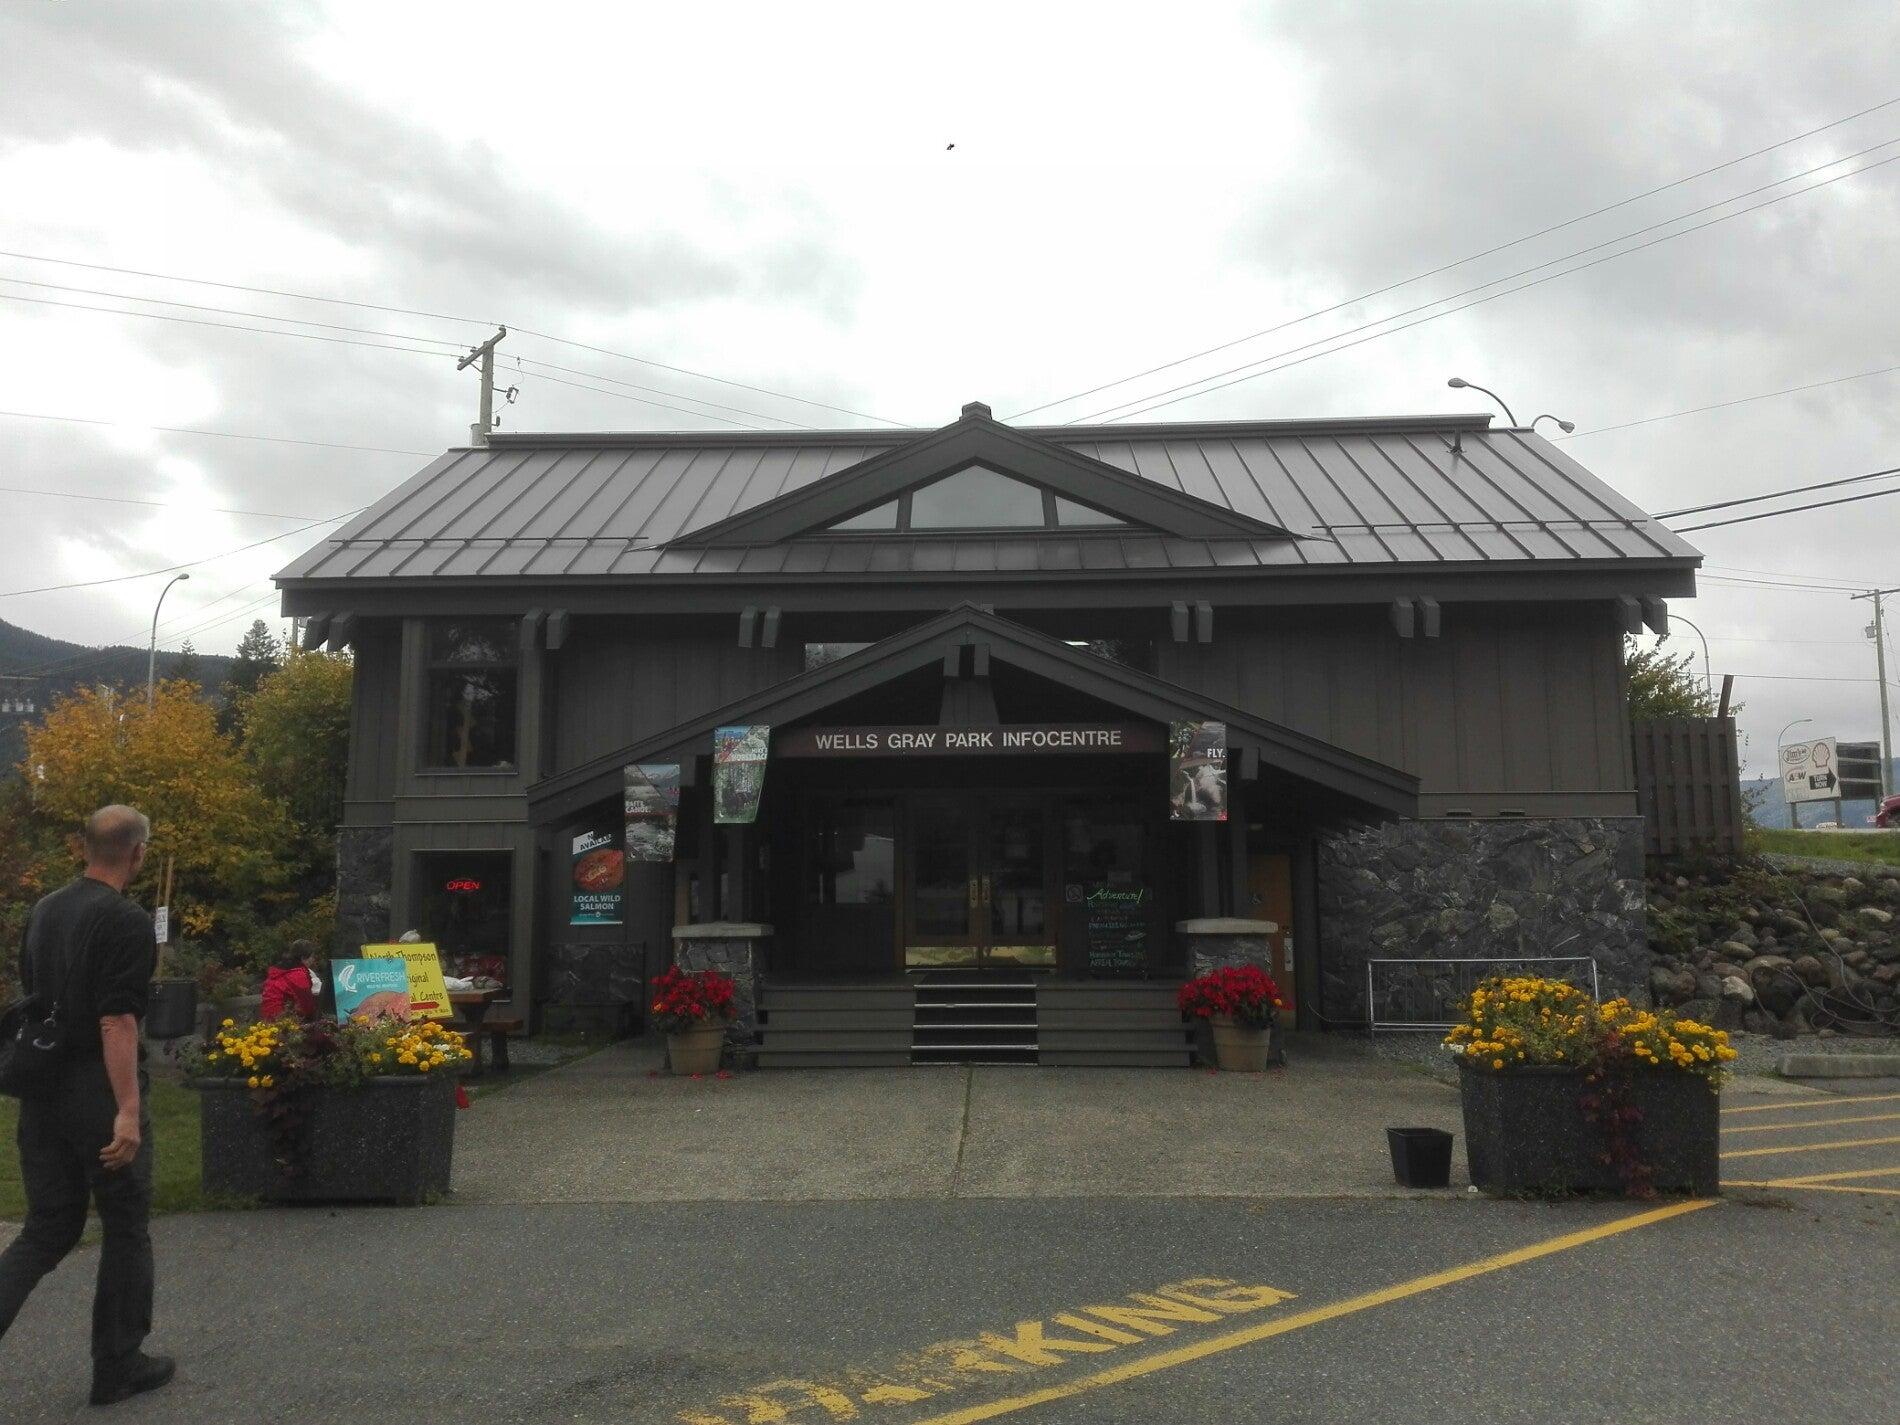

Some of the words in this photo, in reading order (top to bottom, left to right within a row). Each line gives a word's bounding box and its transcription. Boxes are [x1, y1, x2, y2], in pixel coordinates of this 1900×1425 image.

[815, 733, 879, 749] WELLS
[887, 733, 937, 749] GRAY
[945, 732, 993, 748] PARK
[1003, 730, 1122, 747] INFOCENTRE
[1207, 748, 1226, 759] FLY.
[446, 880, 480, 891] OPEN
[573, 895, 600, 903] LOCAL
[600, 894, 621, 902] WILD
[579, 902, 614, 911] SALMON
[356, 971, 406, 983] RIVERFRESH
